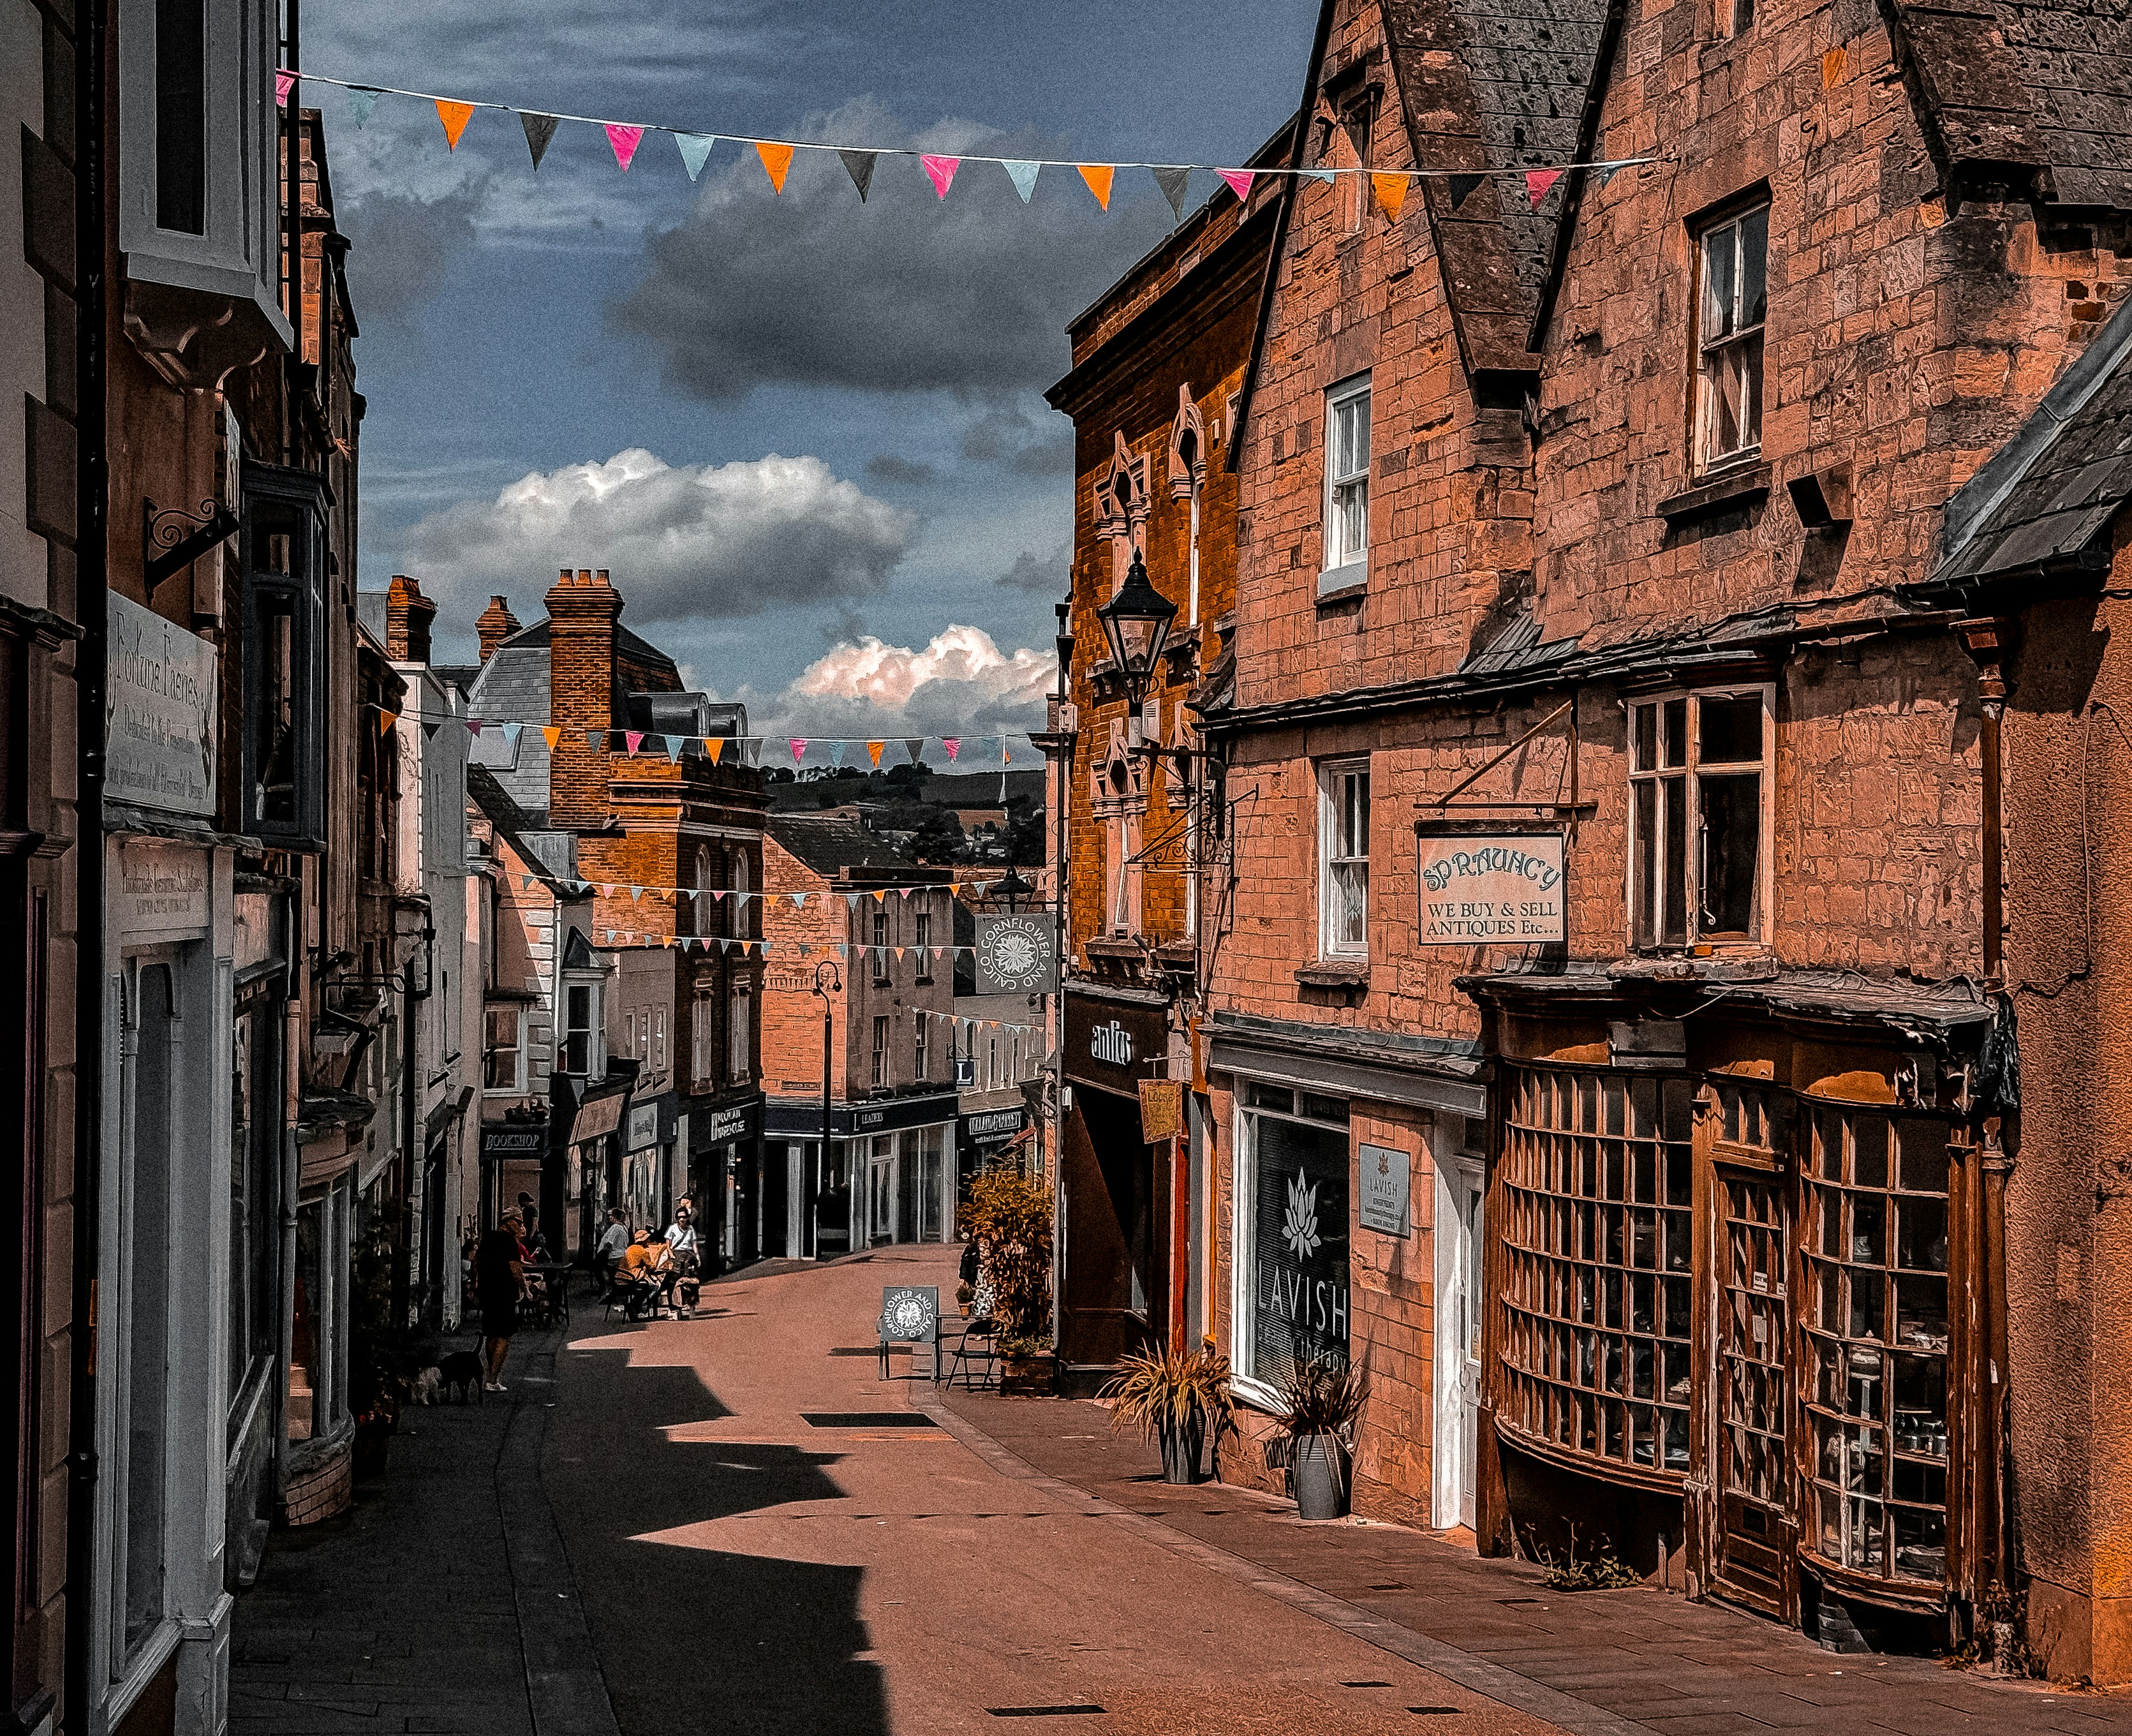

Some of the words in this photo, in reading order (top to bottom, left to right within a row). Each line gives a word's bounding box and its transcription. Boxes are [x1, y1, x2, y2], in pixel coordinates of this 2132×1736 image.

[115, 611, 161, 694] Fortune
[162, 634, 199, 709] Faeries
[1423, 847, 1561, 891] SPRAUNCY
[1427, 903, 1456, 917] WE
[1460, 903, 1495, 917] BUY
[1500, 902, 1515, 917] &
[1520, 902, 1558, 916] SELL
[981, 917, 1051, 958] CORNFLOWER
[1426, 920, 1515, 937] ANTIQUES
[980, 956, 1017, 990] CALICO
[1023, 961, 1047, 987] AND
[957, 1063, 972, 1081] L
[485, 1134, 540, 1150] BOOKSHOP
[1370, 1177, 1398, 1198] LAVISH
[884, 1290, 913, 1337] CORNFLOWER
[915, 1293, 933, 1310] AND
[1259, 1260, 1347, 1340] LAVISH
